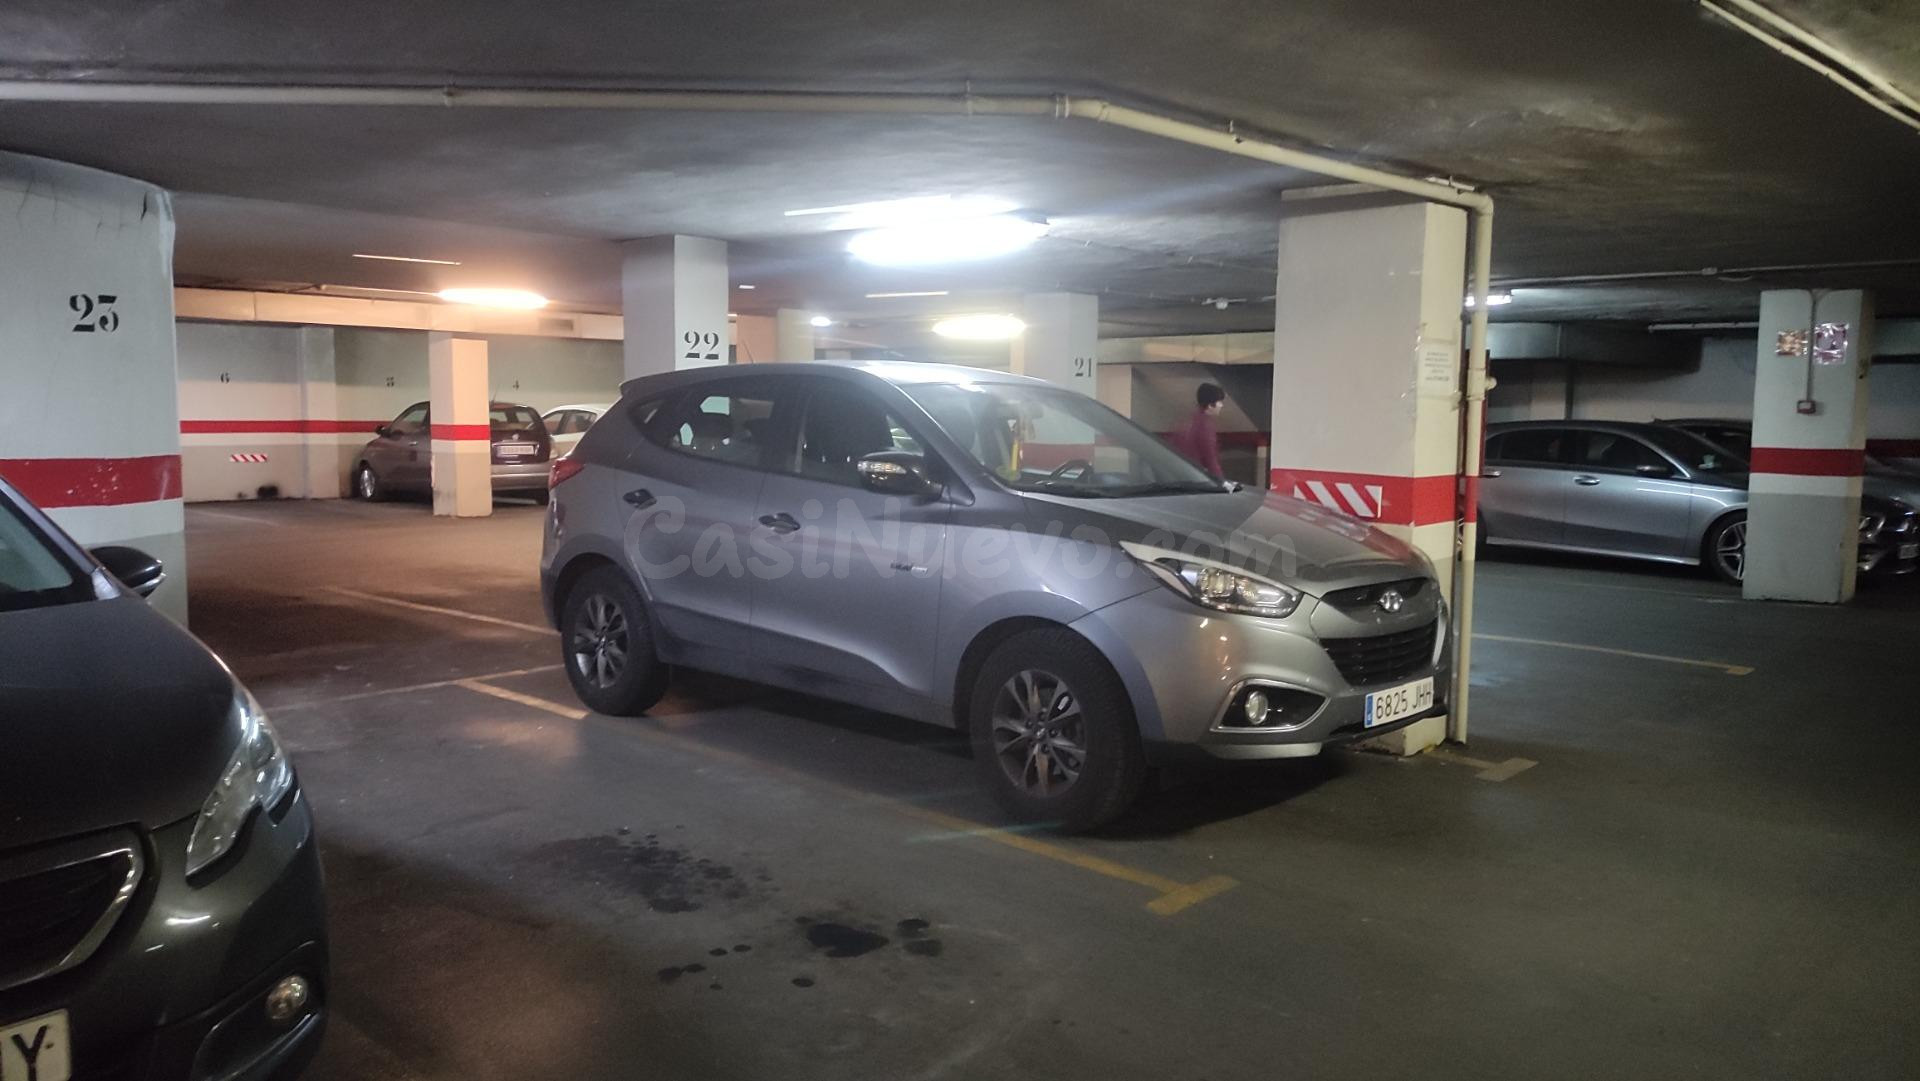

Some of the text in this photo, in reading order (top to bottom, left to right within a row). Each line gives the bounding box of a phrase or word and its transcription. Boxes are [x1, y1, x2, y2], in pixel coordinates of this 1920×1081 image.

[69, 294, 119, 332] 23
[684, 330, 720, 360] 22
[220, 371, 230, 384] 6
[1075, 357, 1092, 377] 21
[1375, 681, 1432, 720] 6825 JHH
[0, 1025, 48, 1081] Y
